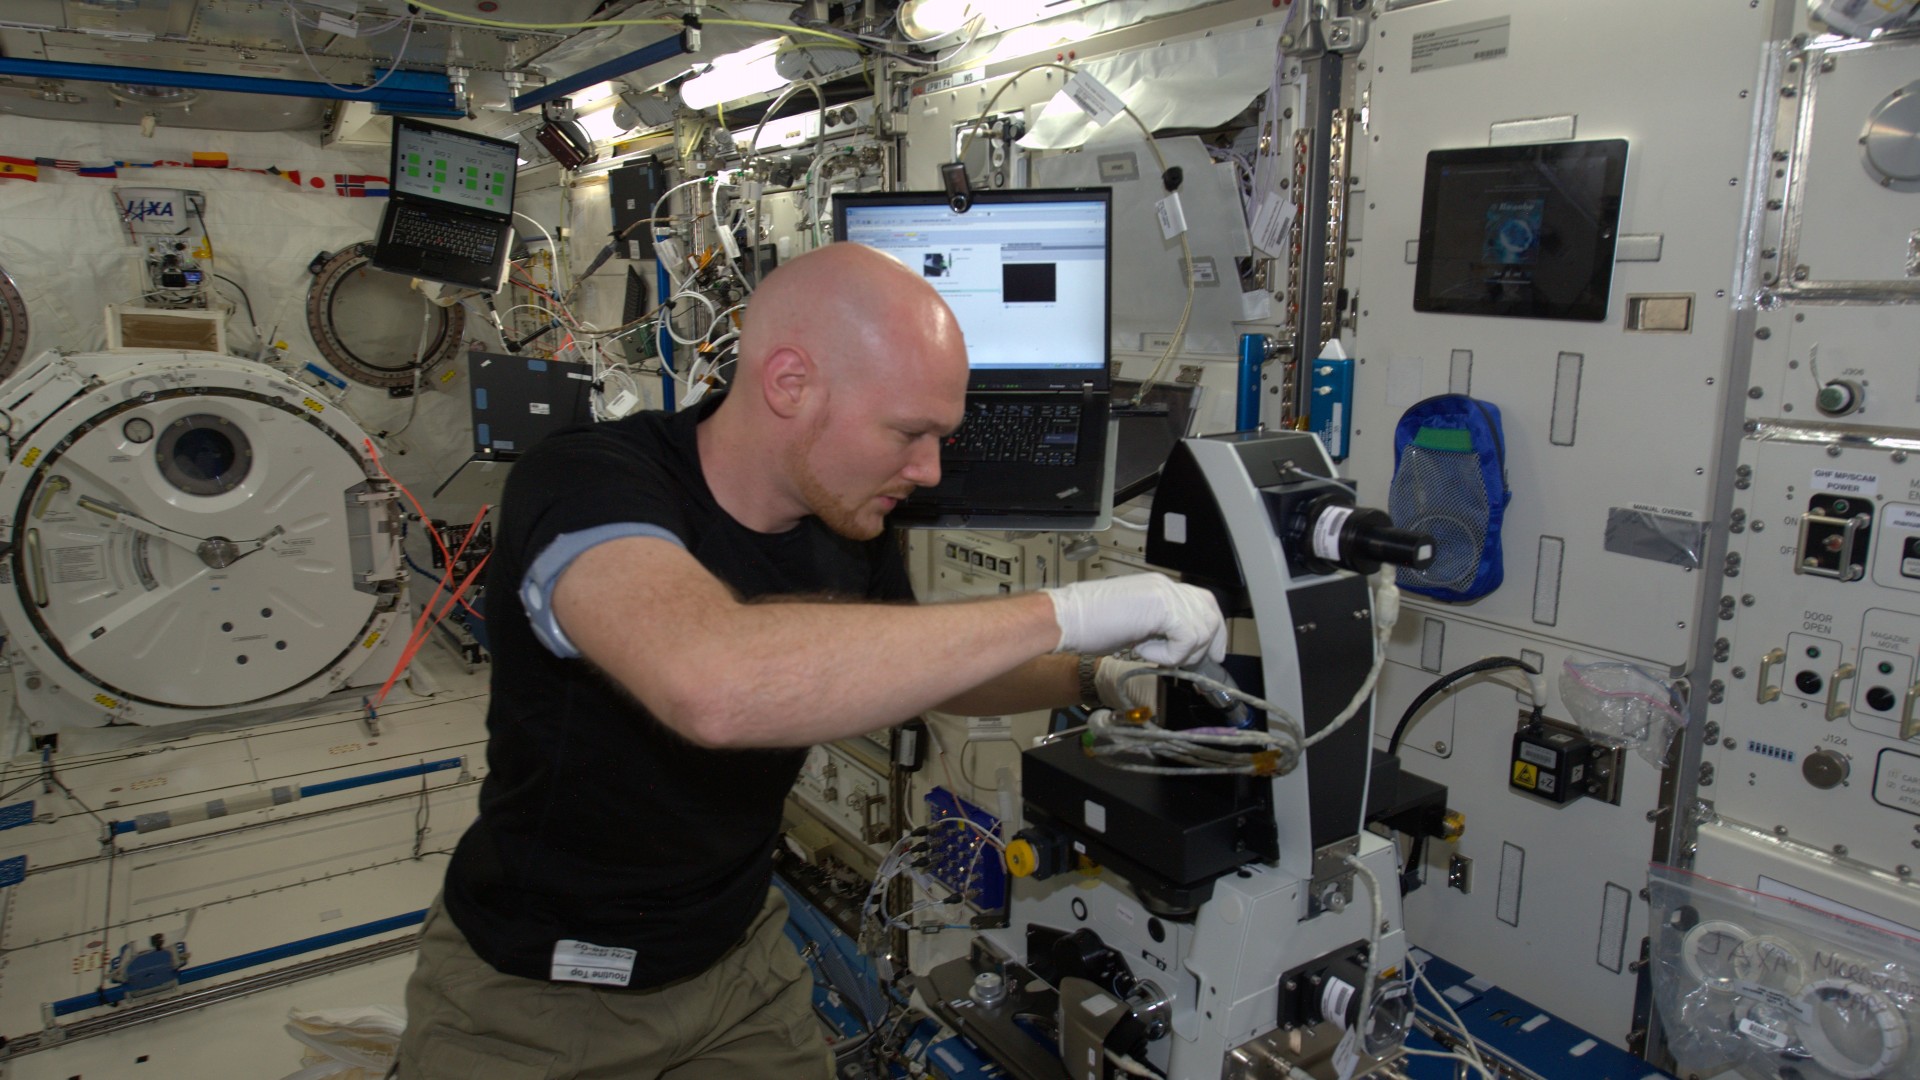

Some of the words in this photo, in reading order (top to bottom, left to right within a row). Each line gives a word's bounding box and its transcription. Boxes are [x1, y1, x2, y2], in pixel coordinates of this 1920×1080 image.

[1814, 469, 1833, 478] GHF
[1826, 482, 1860, 492] POWER
[1633, 503, 1659, 513] MANUAL
[1661, 507, 1694, 518] OVERRIDE
[1783, 516, 1798, 526] ON
[1803, 610, 1833, 623] DOOR
[1802, 621, 1832, 635] OPEN
[1870, 631, 1910, 645] MAGAZINE
[1877, 640, 1900, 651] MOVE
[1822, 733, 1848, 747] J124
[570, 968, 589, 979] Top
[592, 970, 628, 982] Routine
